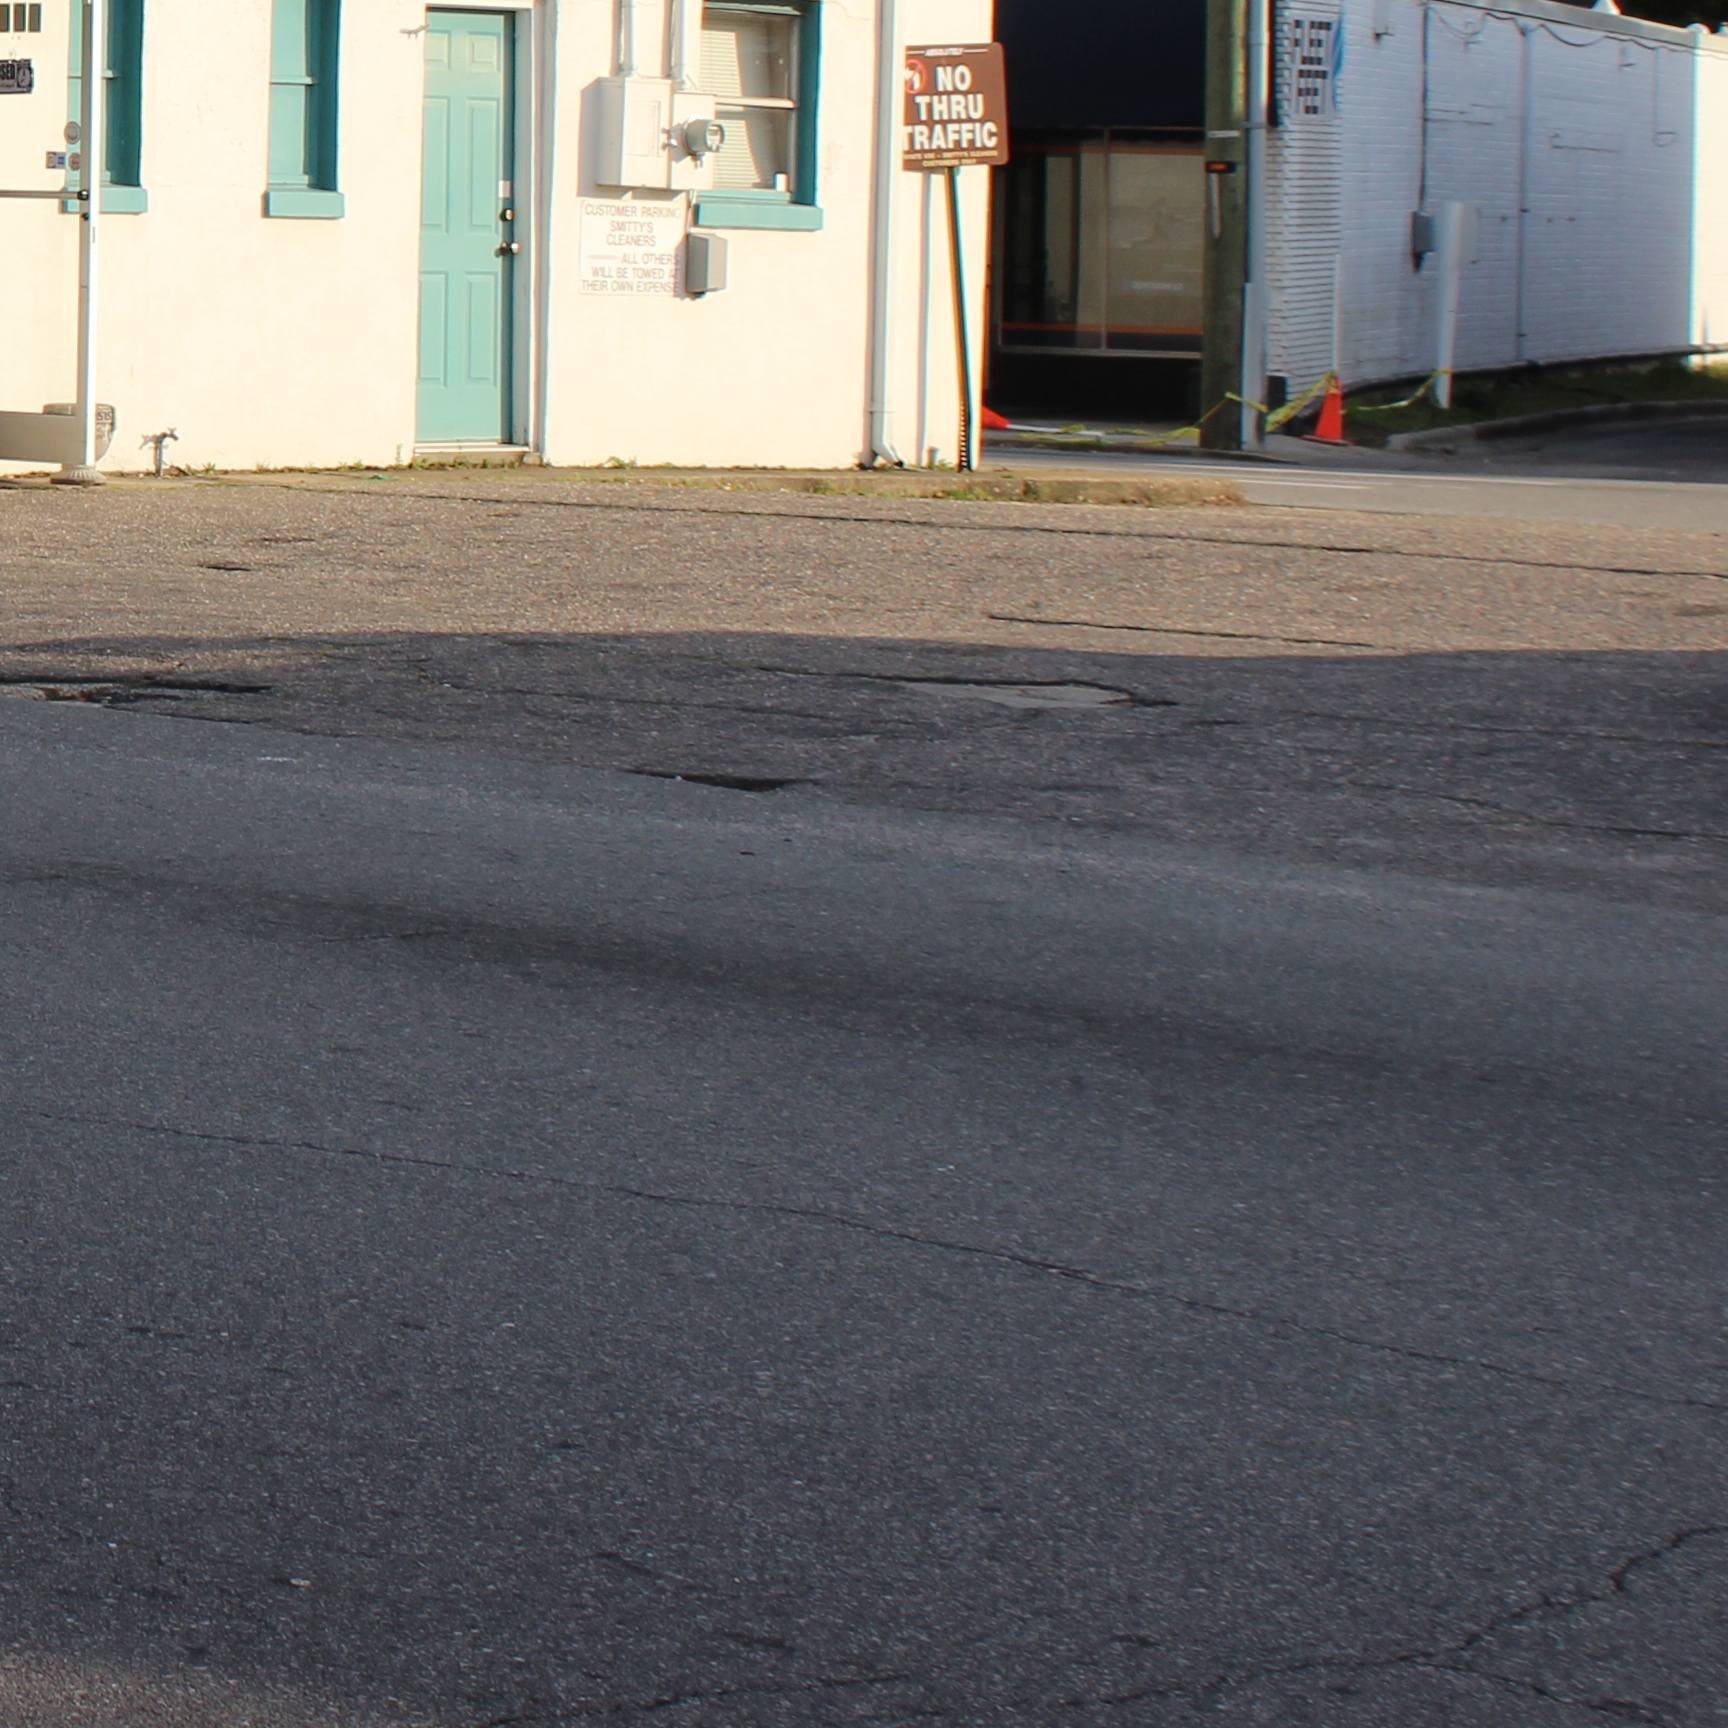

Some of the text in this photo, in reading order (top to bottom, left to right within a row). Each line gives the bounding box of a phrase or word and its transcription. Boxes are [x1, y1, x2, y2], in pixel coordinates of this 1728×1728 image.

[935, 65, 972, 92] NO
[914, 93, 984, 121] THRU
[903, 121, 998, 151] TRAFFIC
[585, 203, 681, 218] CUSTOMER PARKING
[610, 220, 654, 233] SMITTY'S
[606, 233, 656, 247] CLEANERS
[621, 253, 678, 265] ALL OTHERS
[591, 266, 614, 278] WILL
[616, 267, 629, 278] BE
[632, 267, 665, 279] TOWED
[581, 279, 678, 293] THEIR OWN EXPENSE
